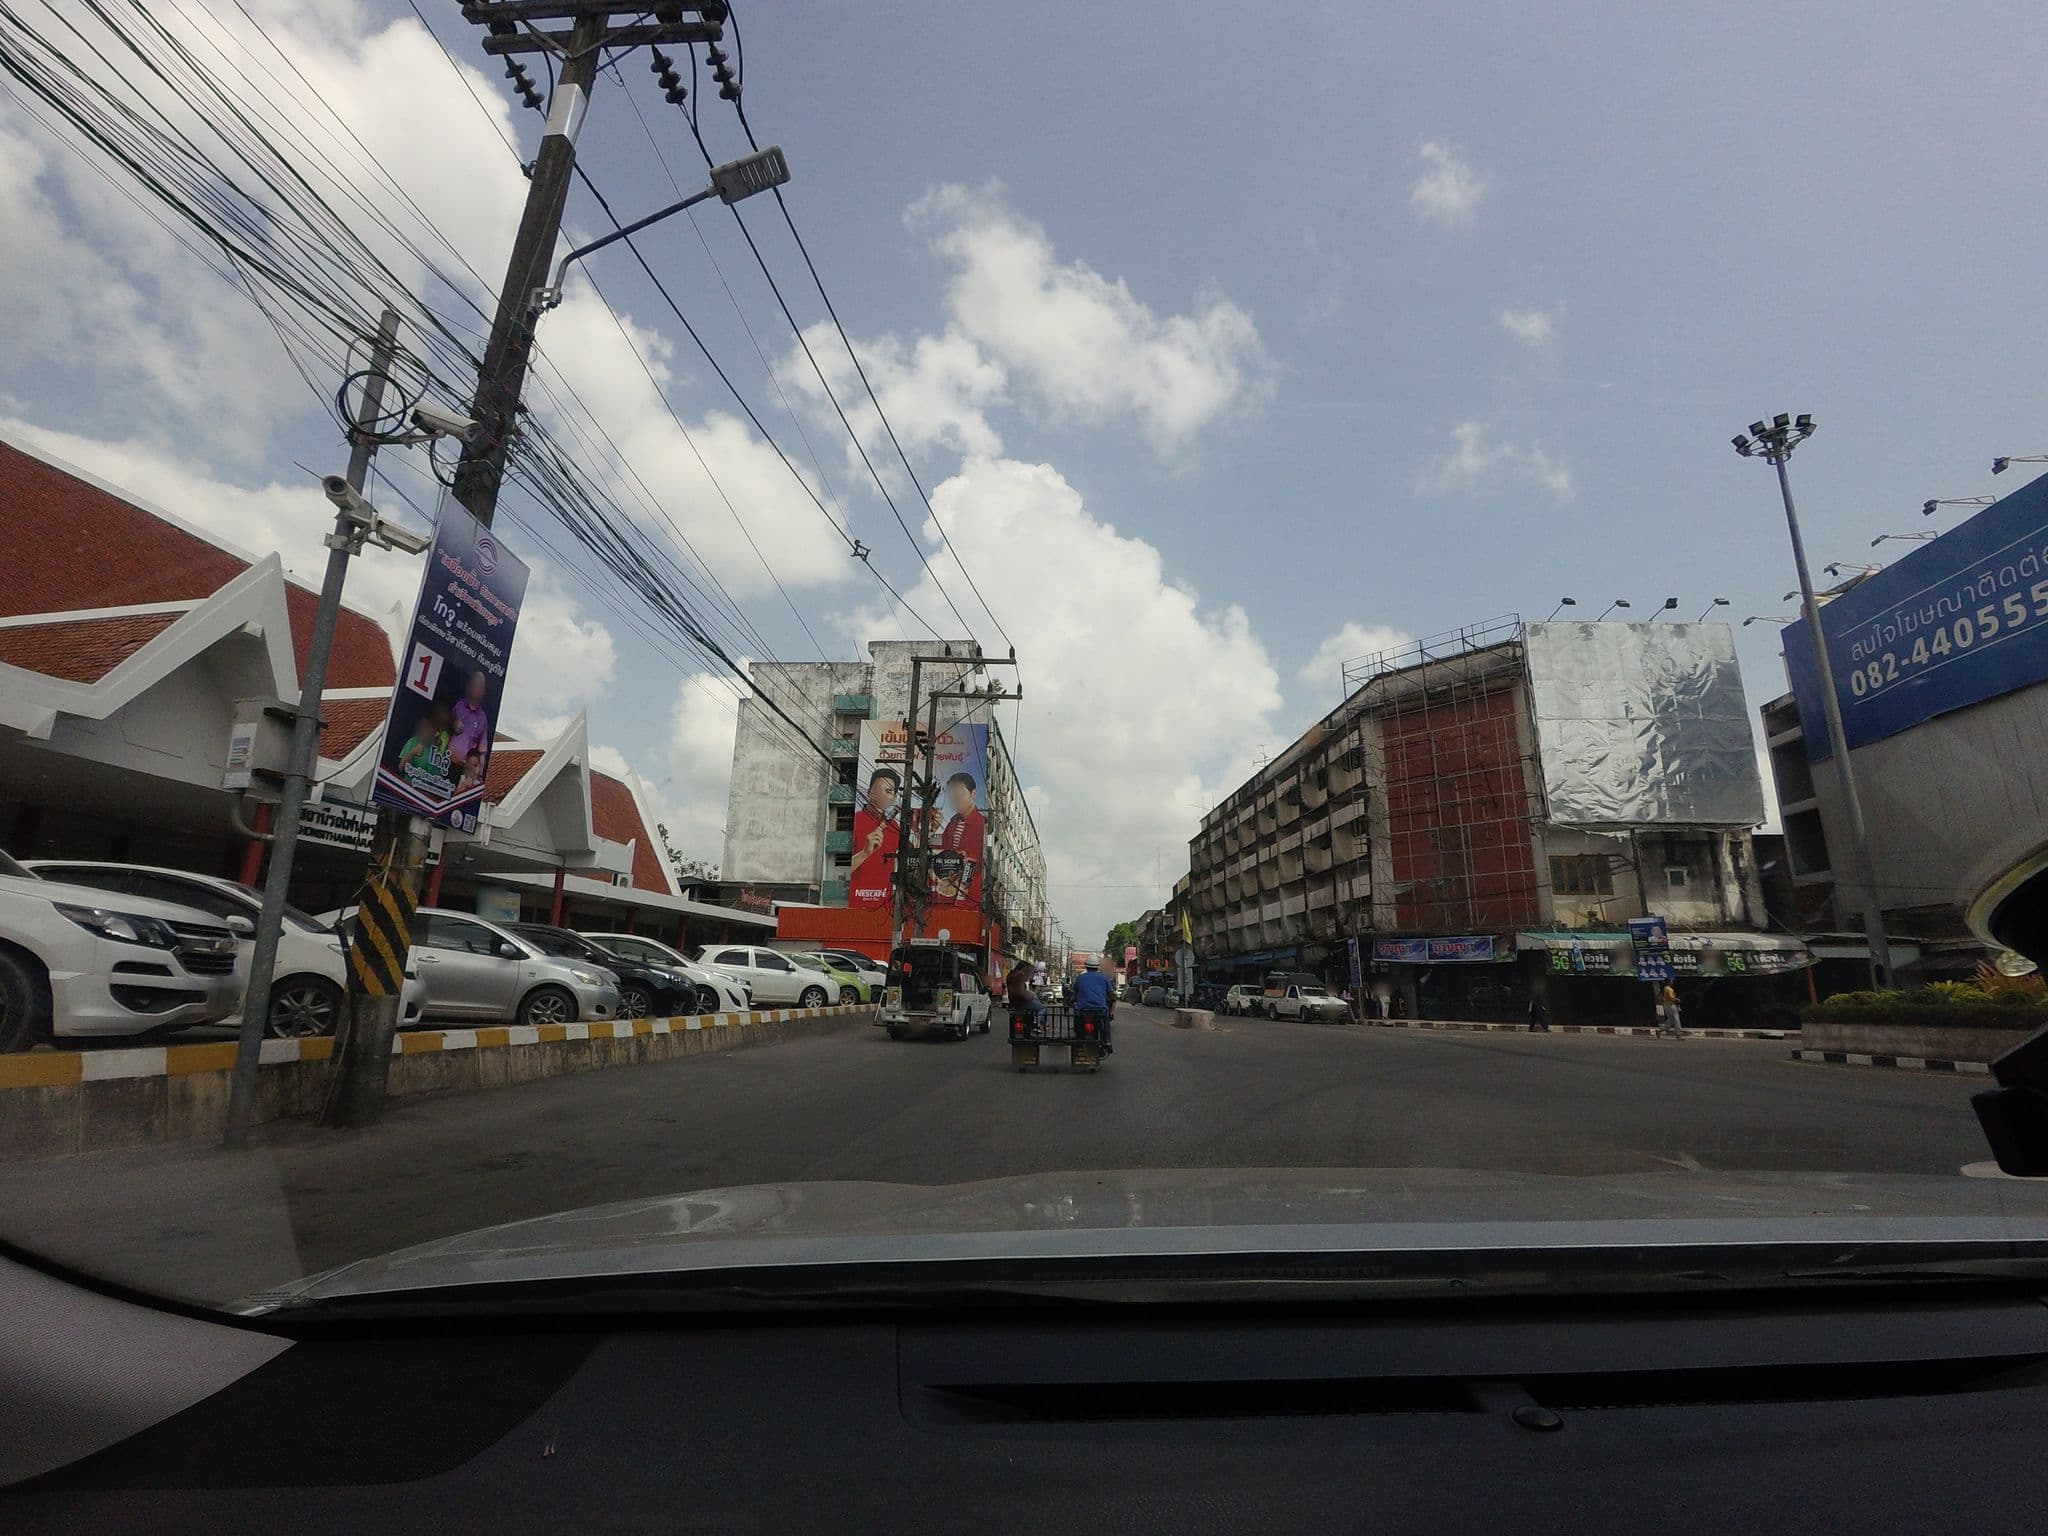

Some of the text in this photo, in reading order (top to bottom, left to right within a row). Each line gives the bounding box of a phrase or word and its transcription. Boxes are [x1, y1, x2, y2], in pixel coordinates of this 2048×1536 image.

[1850, 579, 2048, 697] 082-440555
[414, 655, 433, 692] 1
[1552, 956, 1569, 970] 5G
[1728, 957, 1745, 971] 5G
